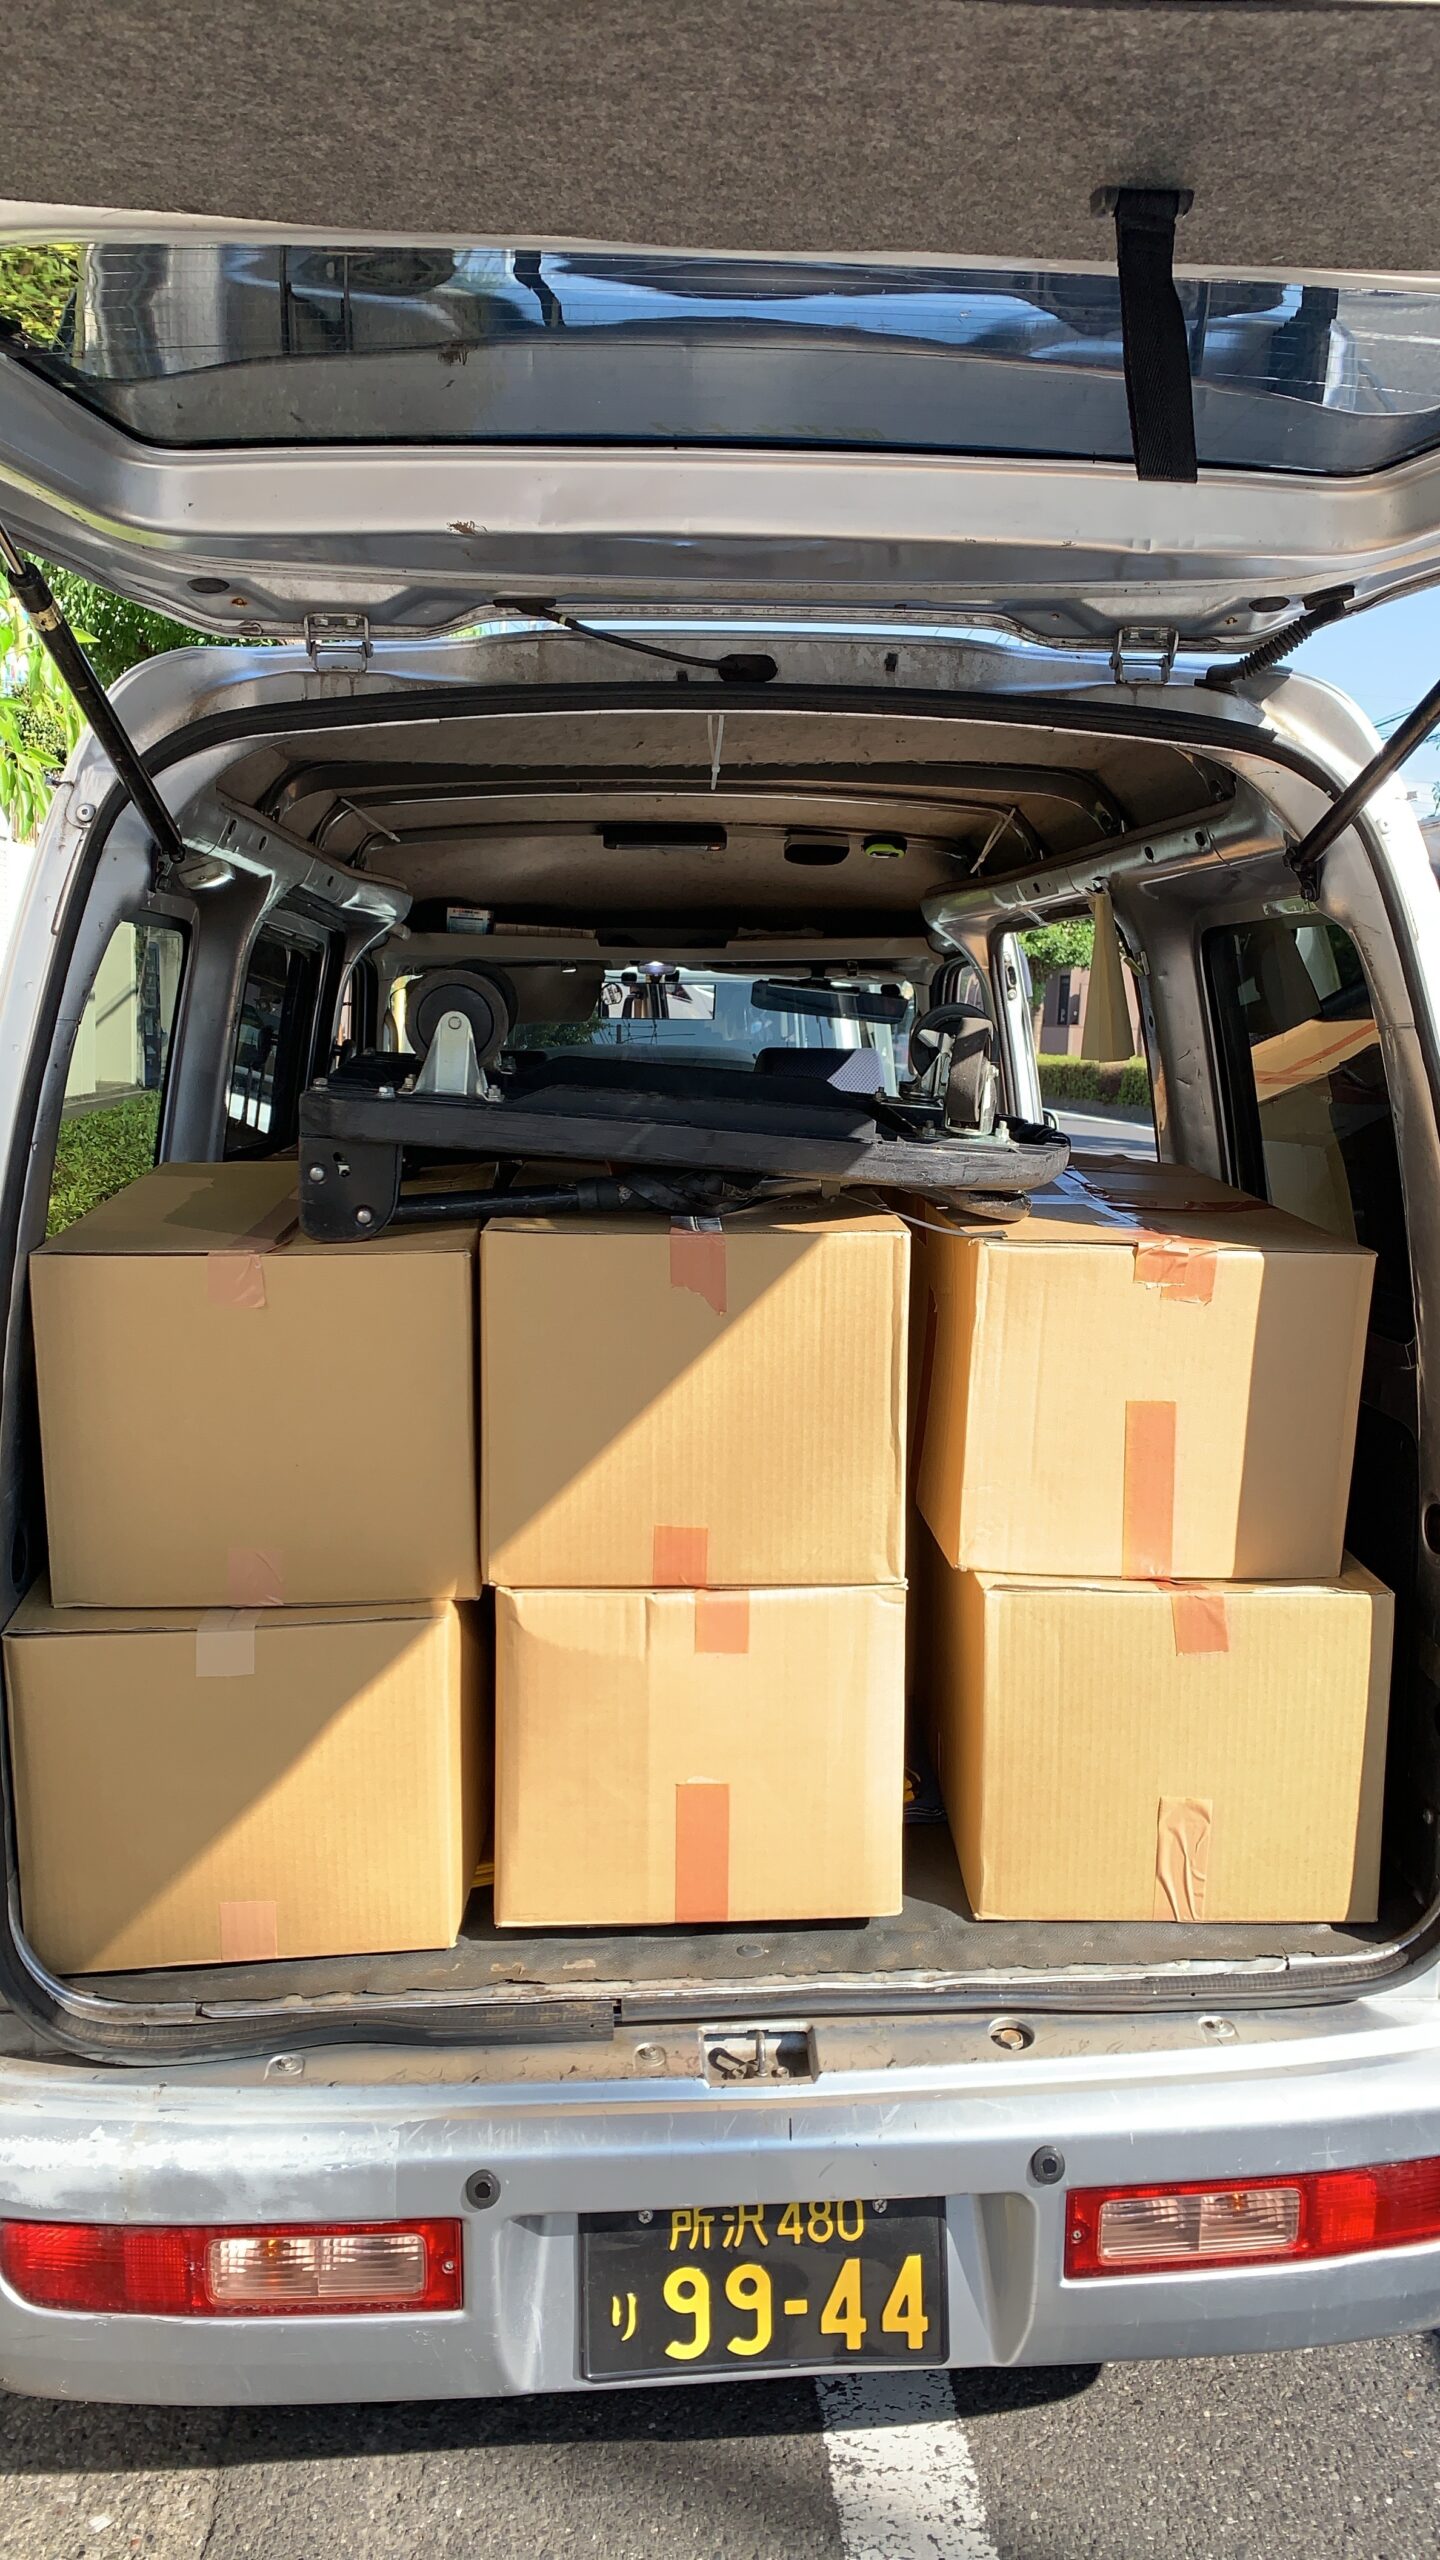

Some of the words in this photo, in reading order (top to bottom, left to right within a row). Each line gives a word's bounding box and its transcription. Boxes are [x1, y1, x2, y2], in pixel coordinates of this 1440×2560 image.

[668, 2203, 769, 2251] 所沢
[777, 2199, 865, 2245] 480
[611, 2292, 638, 2342] り
[662, 2253, 930, 2361] 99-44
